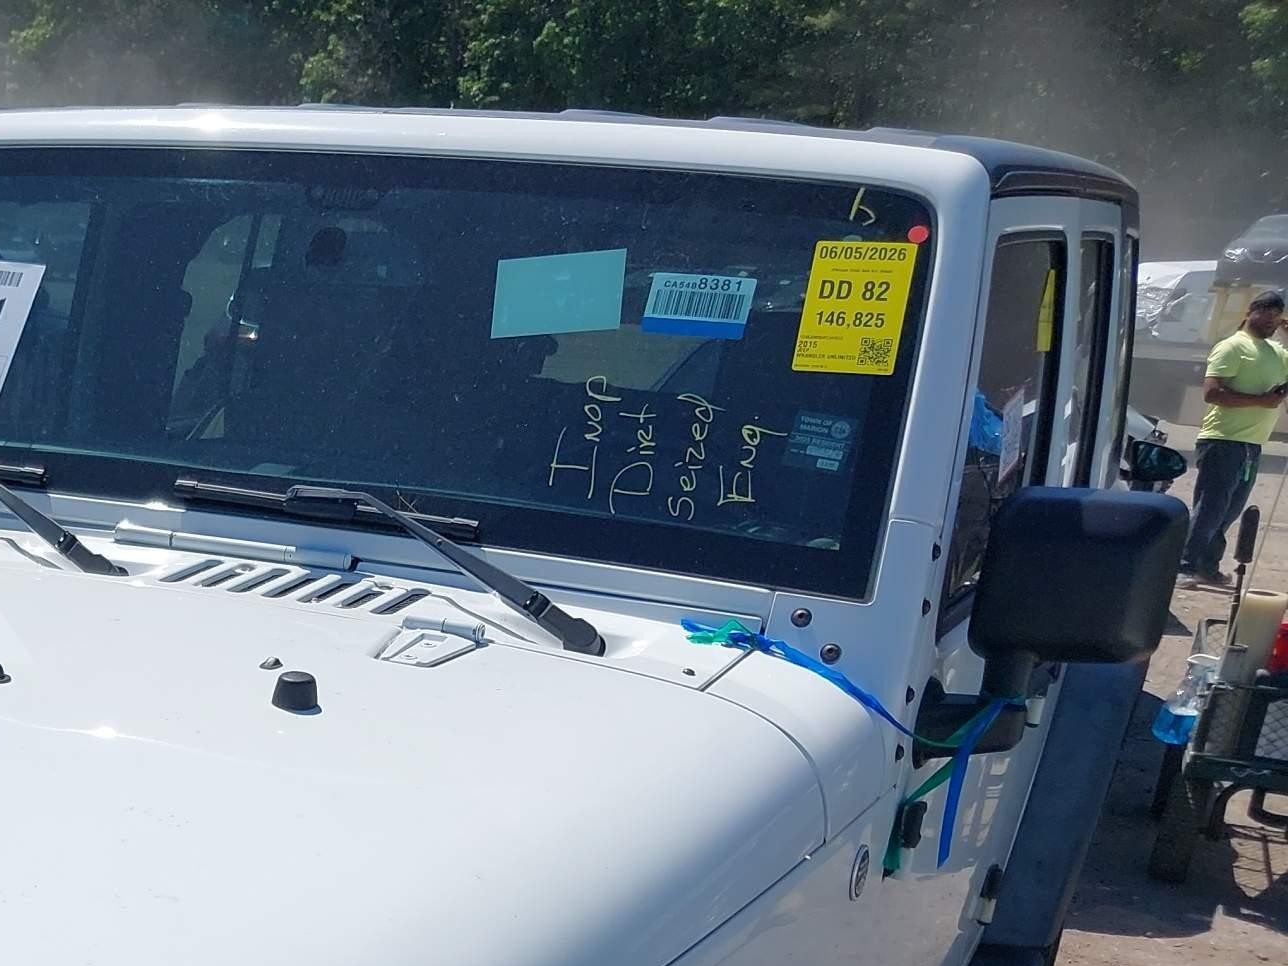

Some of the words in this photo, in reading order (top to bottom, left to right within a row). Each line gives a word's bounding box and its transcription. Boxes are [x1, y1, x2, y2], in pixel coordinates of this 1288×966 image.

[819, 245, 907, 261] 06/05/2026
[818, 279, 853, 300] DD
[861, 281, 891, 302] 82
[816, 311, 886, 329] 146,825
